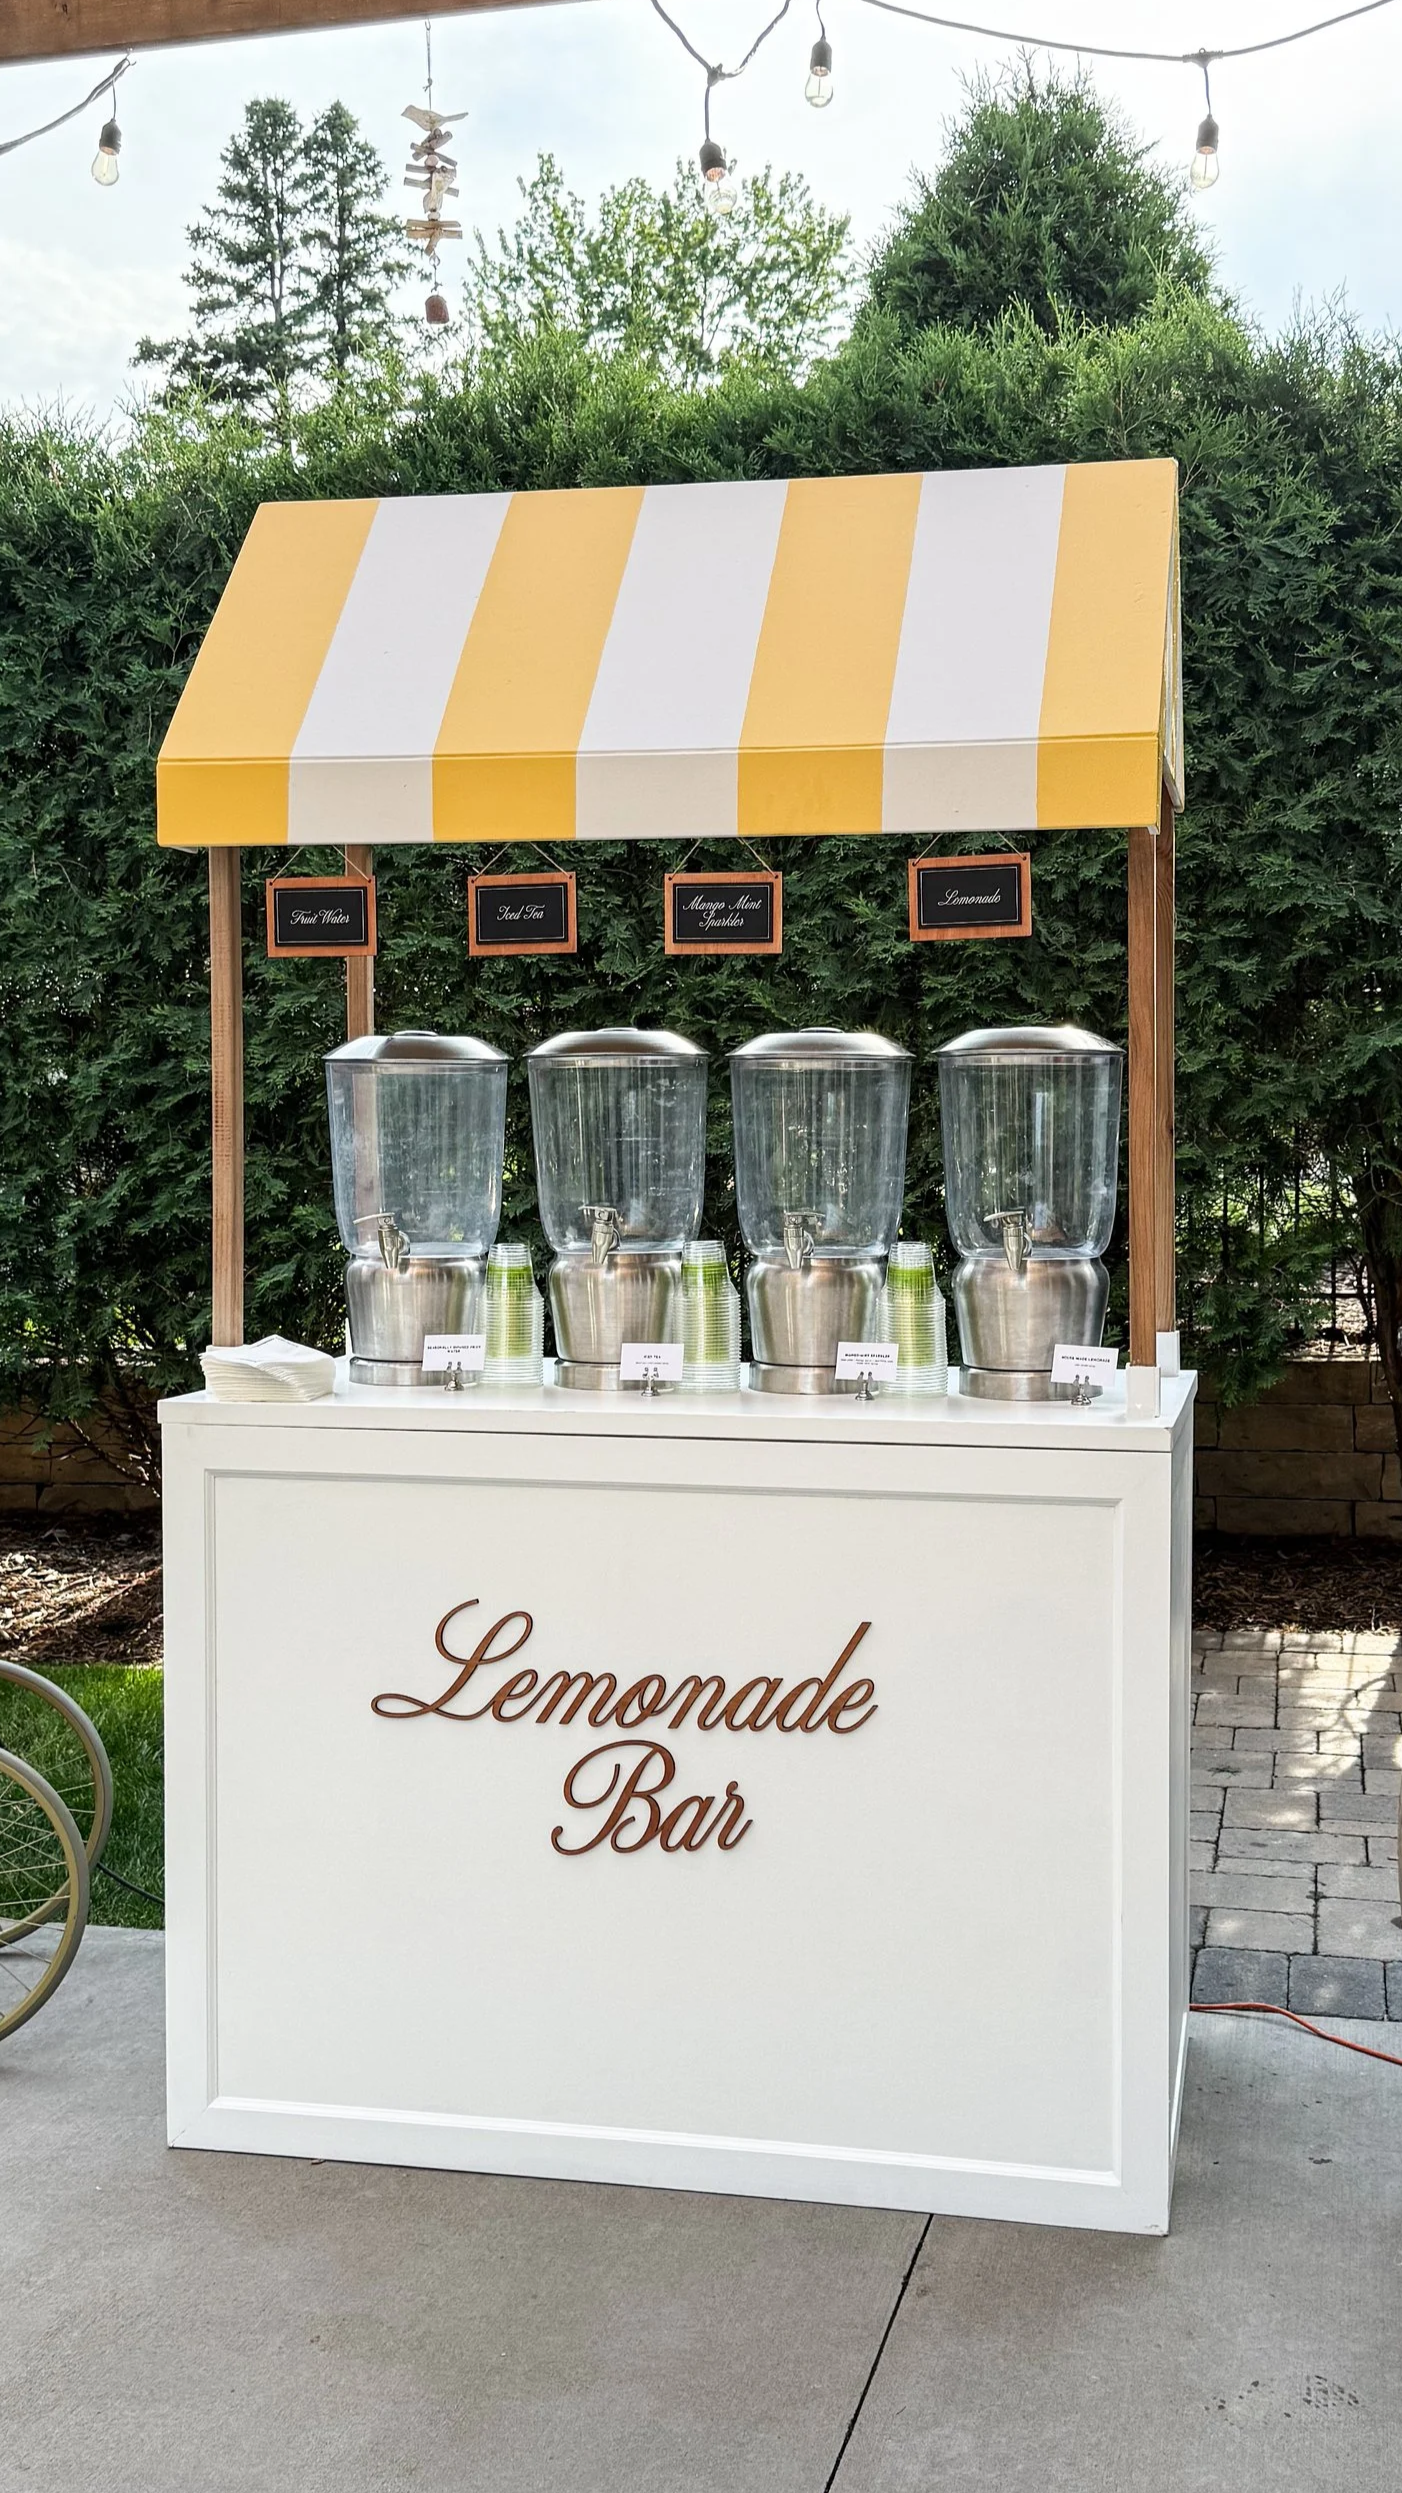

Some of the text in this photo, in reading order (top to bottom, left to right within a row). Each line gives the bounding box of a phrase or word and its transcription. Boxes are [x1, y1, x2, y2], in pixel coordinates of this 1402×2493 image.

[682, 894, 762, 915] Mango Mint
[937, 888, 1001, 906] Lemonade
[290, 908, 350, 925] Fruit Water
[496, 904, 545, 921] Iced Tea
[698, 910, 745, 931] Sparkler
[370, 1598, 879, 1735] Lemonade
[550, 1739, 754, 1856] Bar
